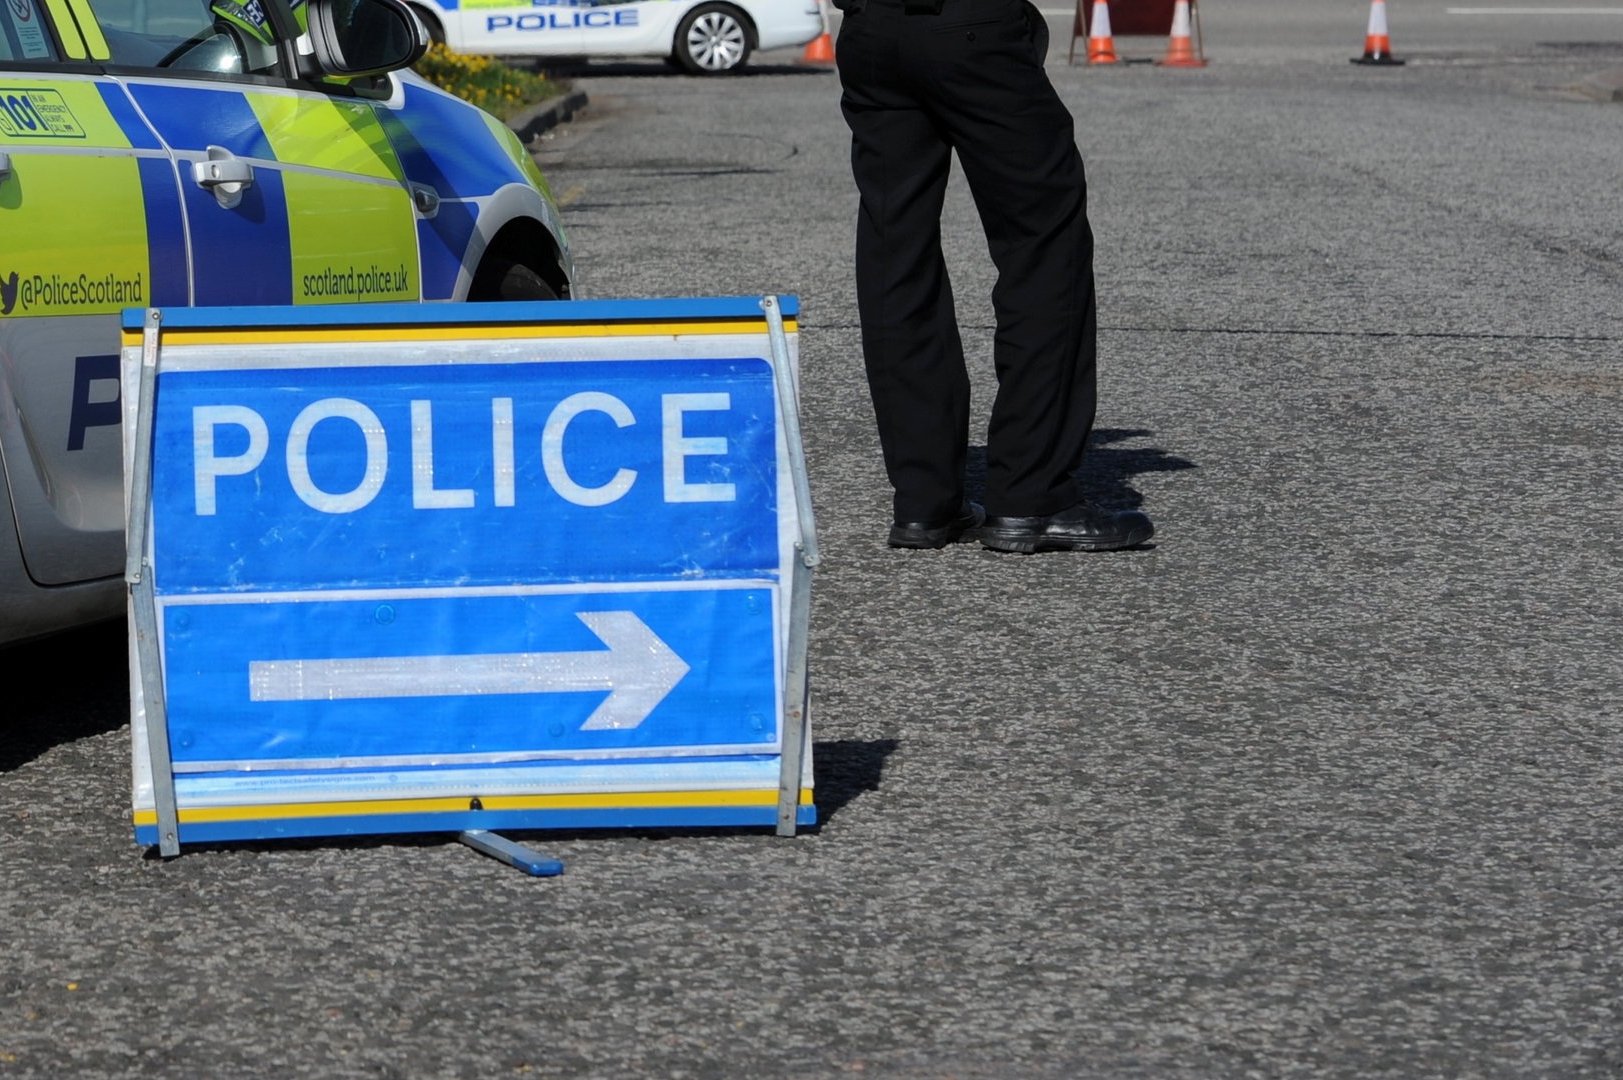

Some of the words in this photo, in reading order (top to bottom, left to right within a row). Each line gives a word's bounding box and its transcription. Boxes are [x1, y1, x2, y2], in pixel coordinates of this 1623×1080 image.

[487, 9, 640, 33] POLICE
[20, 272, 143, 311] @PoliceScotland
[303, 264, 409, 302] scotland.police.uk
[192, 391, 736, 516] POLICE
